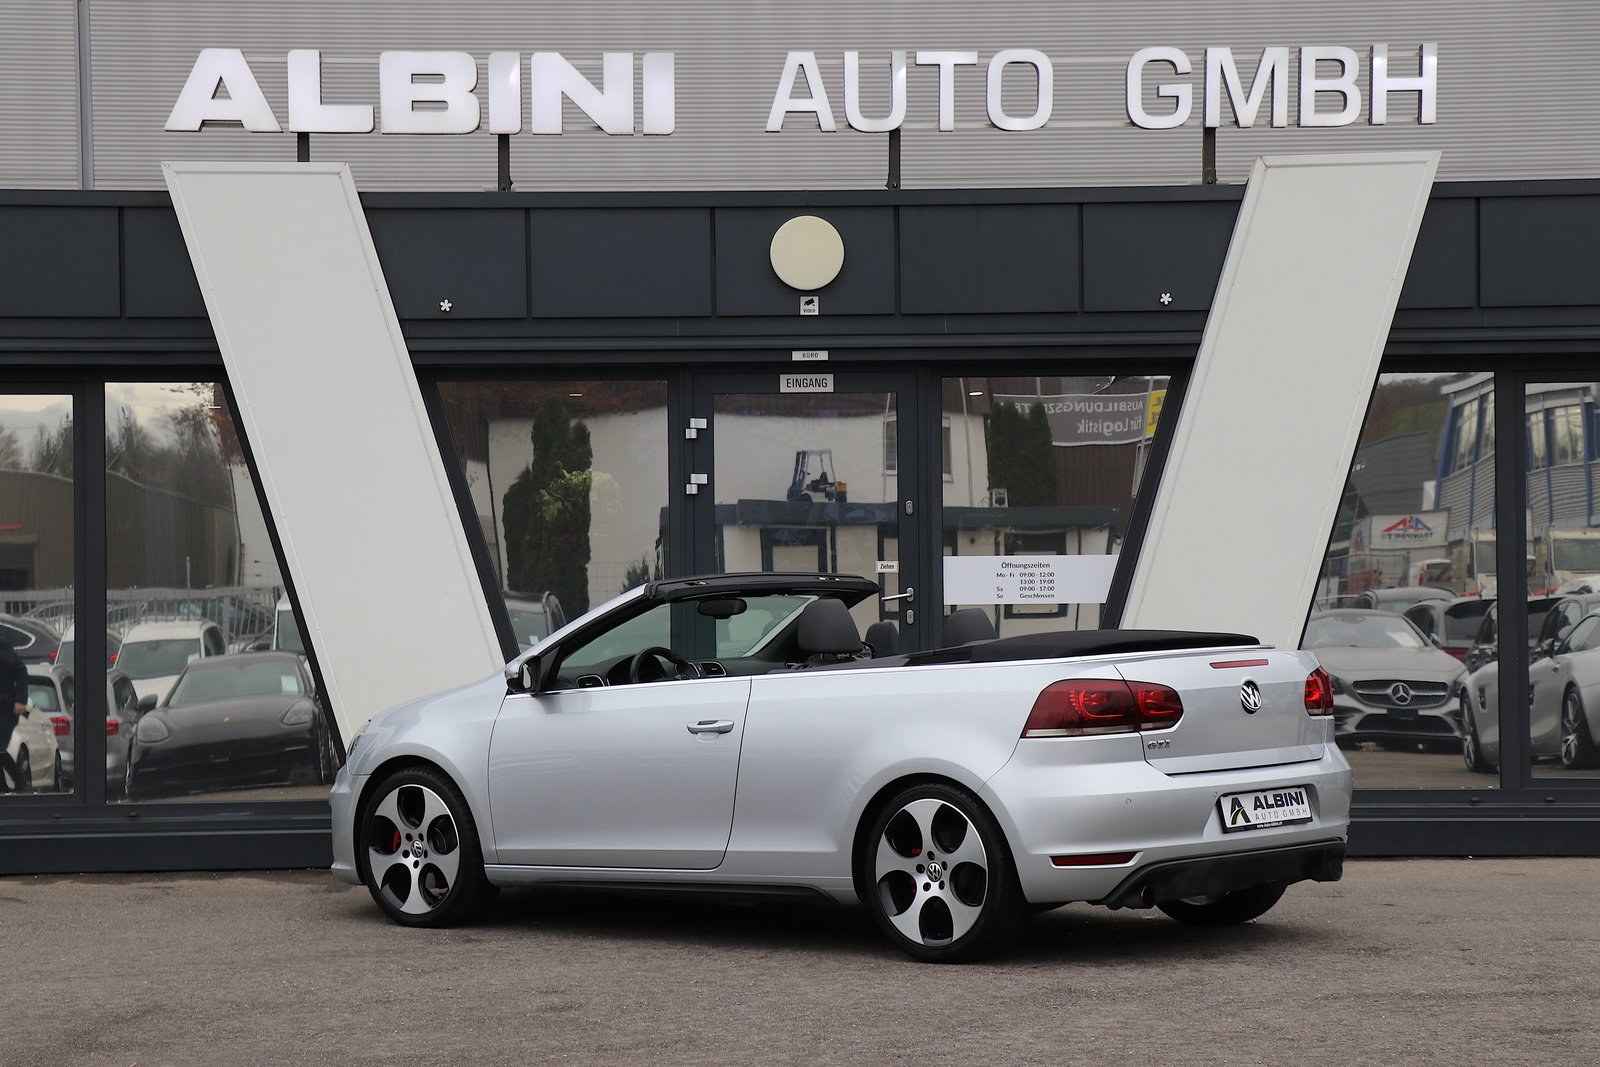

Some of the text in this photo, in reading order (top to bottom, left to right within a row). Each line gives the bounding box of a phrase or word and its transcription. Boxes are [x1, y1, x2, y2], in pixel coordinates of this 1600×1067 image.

[164, 42, 1438, 136] ALBINI AUTO GMBH
[786, 378, 828, 388] EINGANG
[1001, 561, 1050, 569] Öffnungszeiten
[1253, 790, 1304, 810] ALBINI
[1255, 807, 1308, 821] AUTO GMBH
